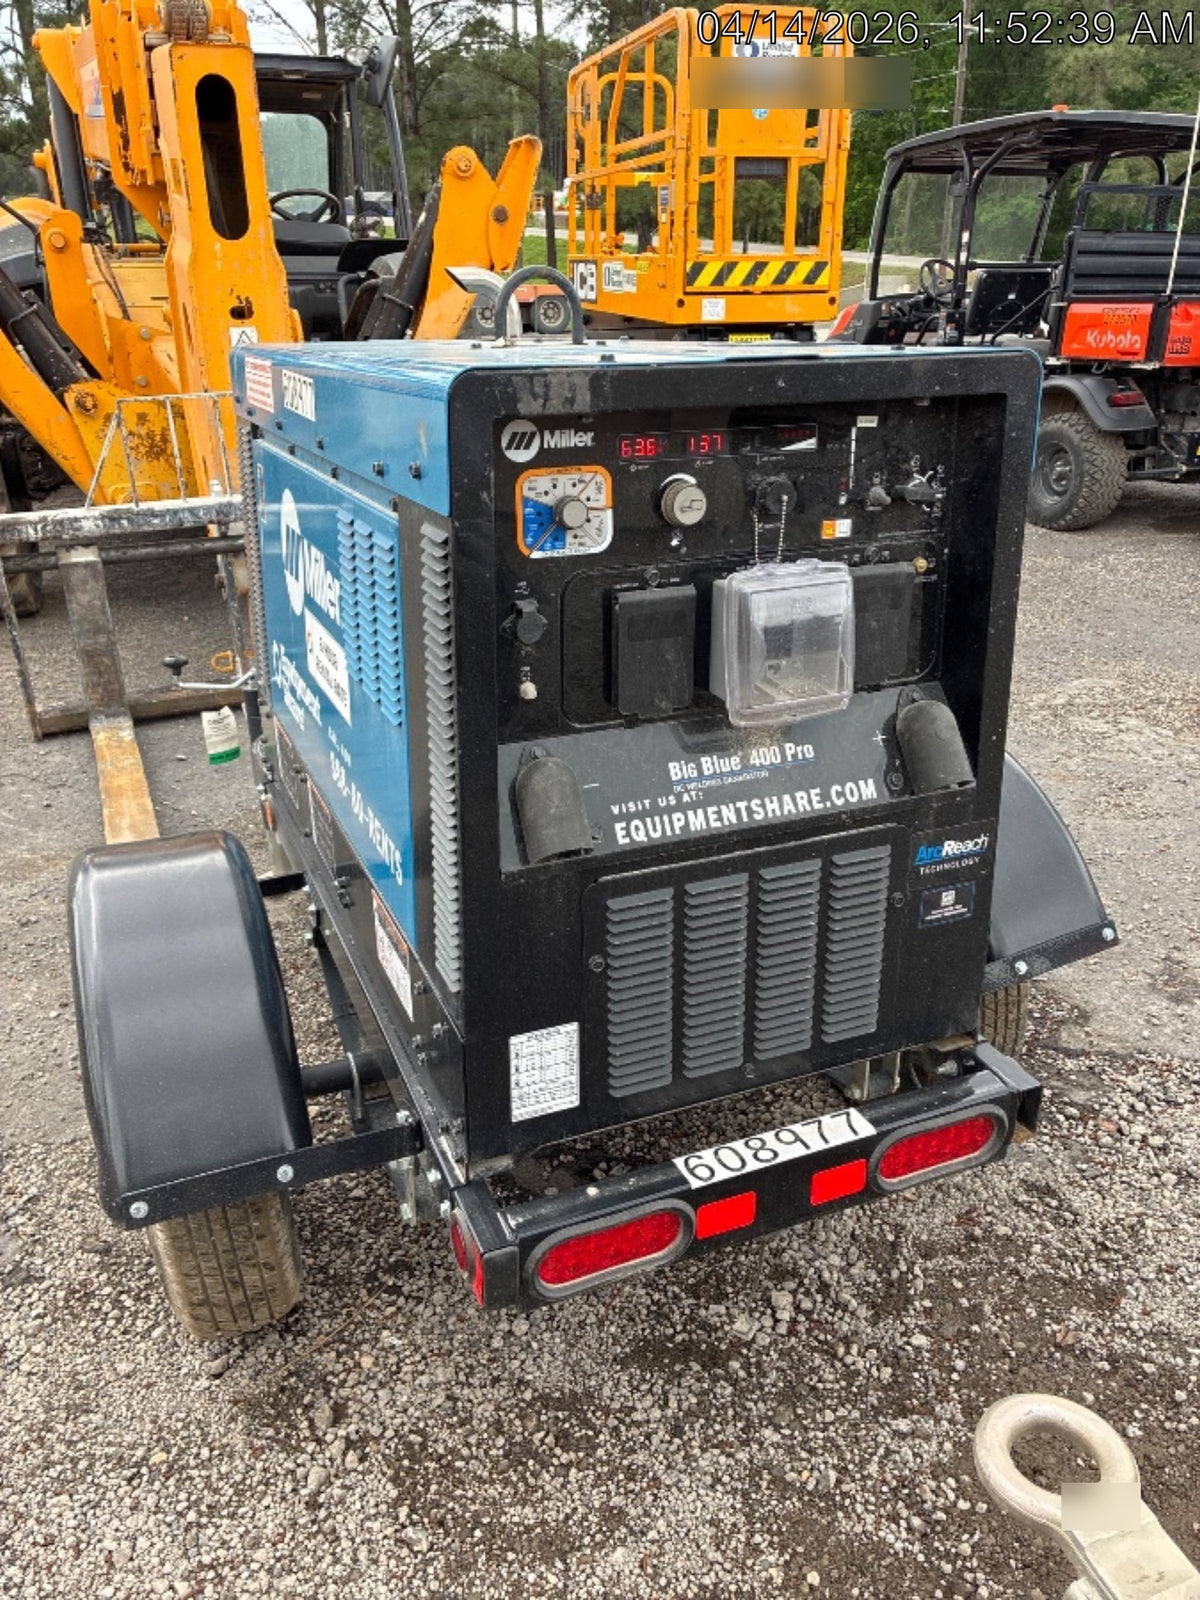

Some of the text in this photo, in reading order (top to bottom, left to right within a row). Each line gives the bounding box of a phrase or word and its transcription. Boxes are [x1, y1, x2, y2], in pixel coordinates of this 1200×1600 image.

[1086, 330, 1141, 349] Kubota
[543, 428, 594, 449] Miller
[688, 434, 723, 453] 137
[700, 754, 742, 776] Blue
[750, 746, 781, 767] 400
[785, 742, 815, 762] Pro
[611, 790, 704, 815] VISIT US AT:
[614, 778, 878, 845] EQUIPMENTSHARE.COM
[915, 833, 989, 860] ArcReach
[920, 857, 980, 875] TECHNOLOGY
[684, 1110, 859, 1183] 608977
